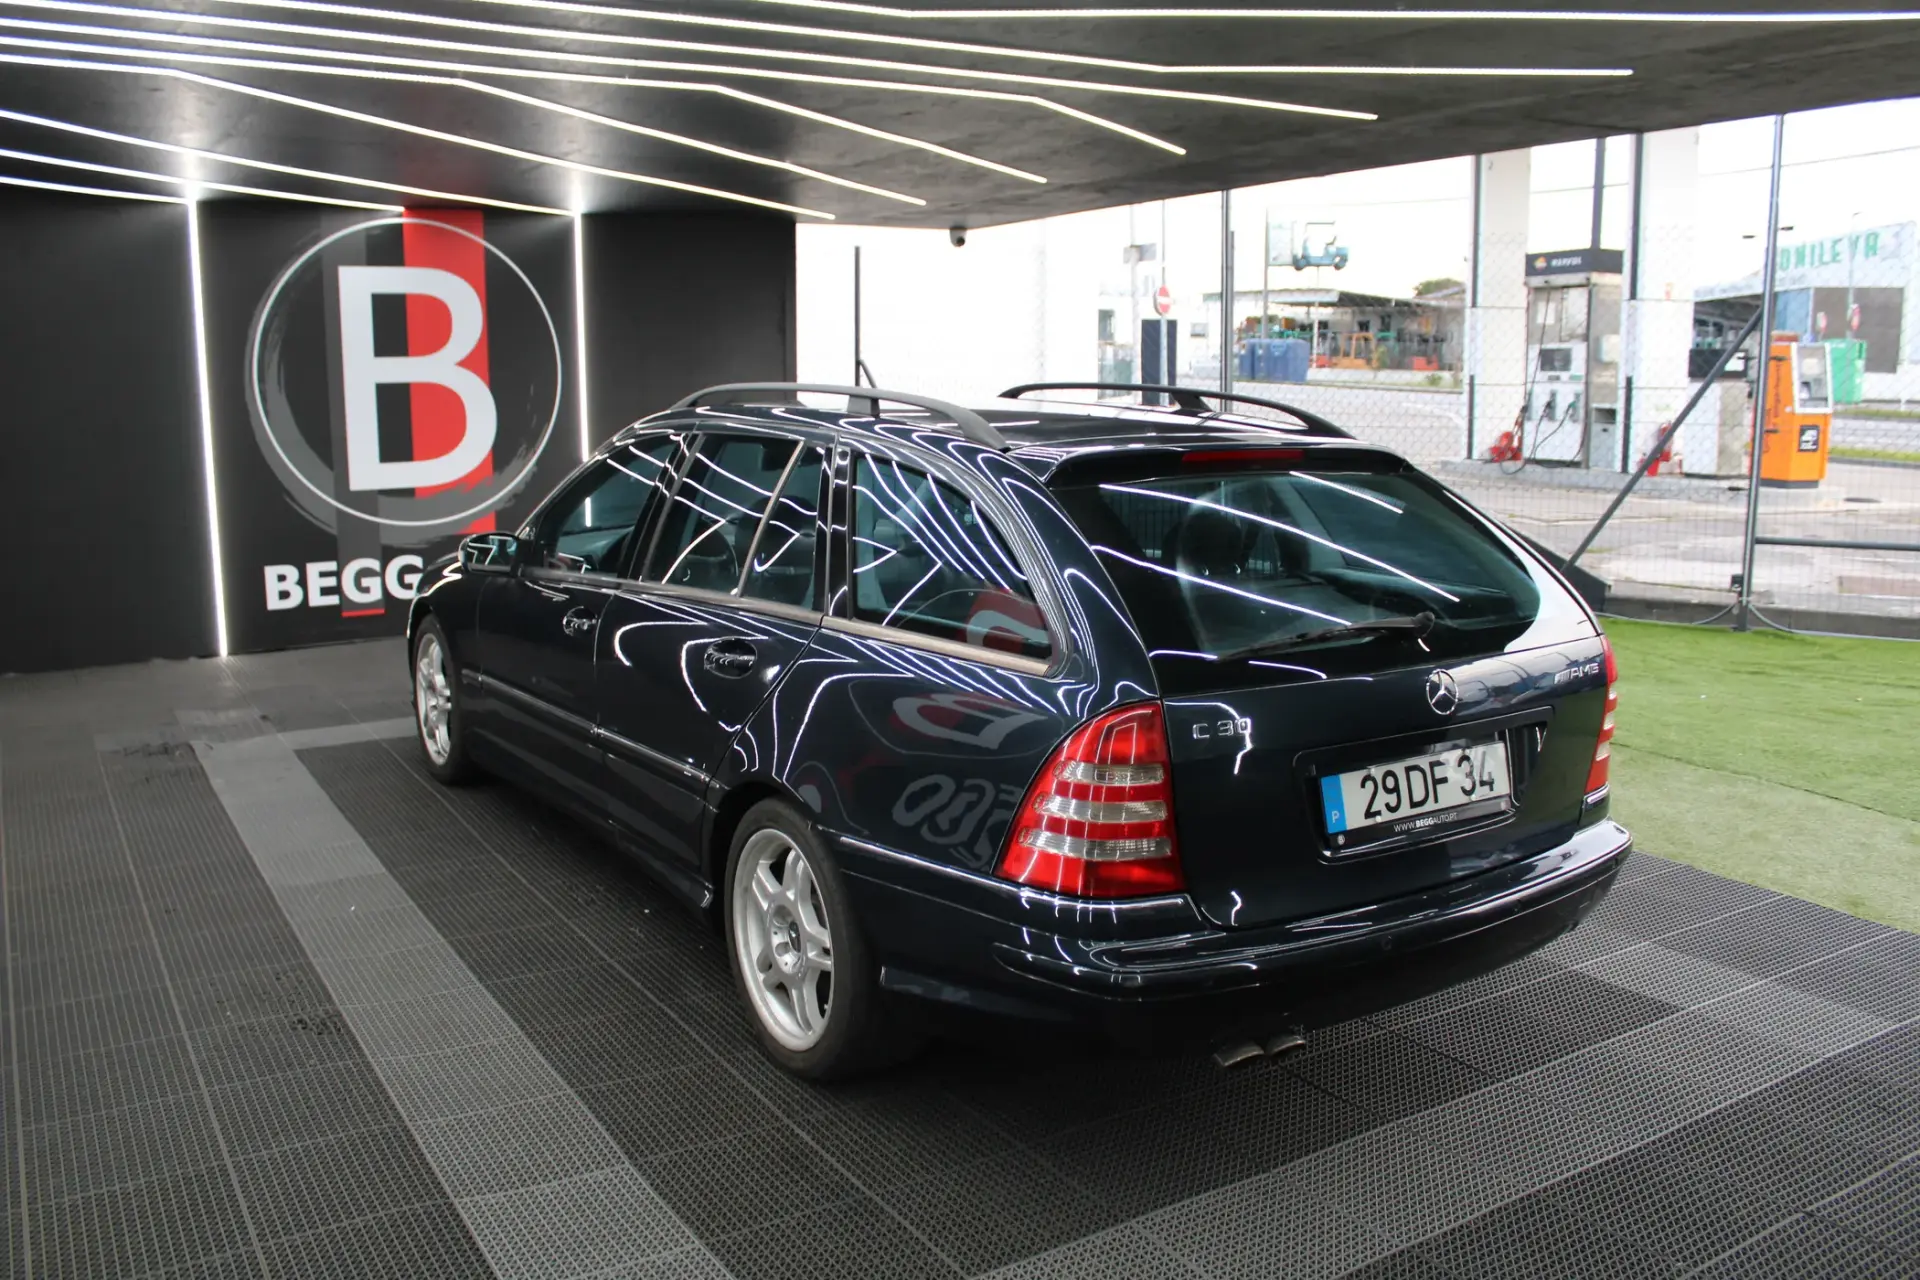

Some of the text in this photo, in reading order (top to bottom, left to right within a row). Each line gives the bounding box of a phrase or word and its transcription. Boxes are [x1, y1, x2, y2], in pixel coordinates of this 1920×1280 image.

[338, 265, 498, 492] B
[263, 554, 424, 612] BEGG
[1569, 662, 1600, 680] AMG
[1192, 723, 1211, 740] C
[1457, 750, 1496, 798] 34
[1331, 810, 1341, 824] P
[1393, 811, 1459, 833] WWW.BEGGAUTO.PT
